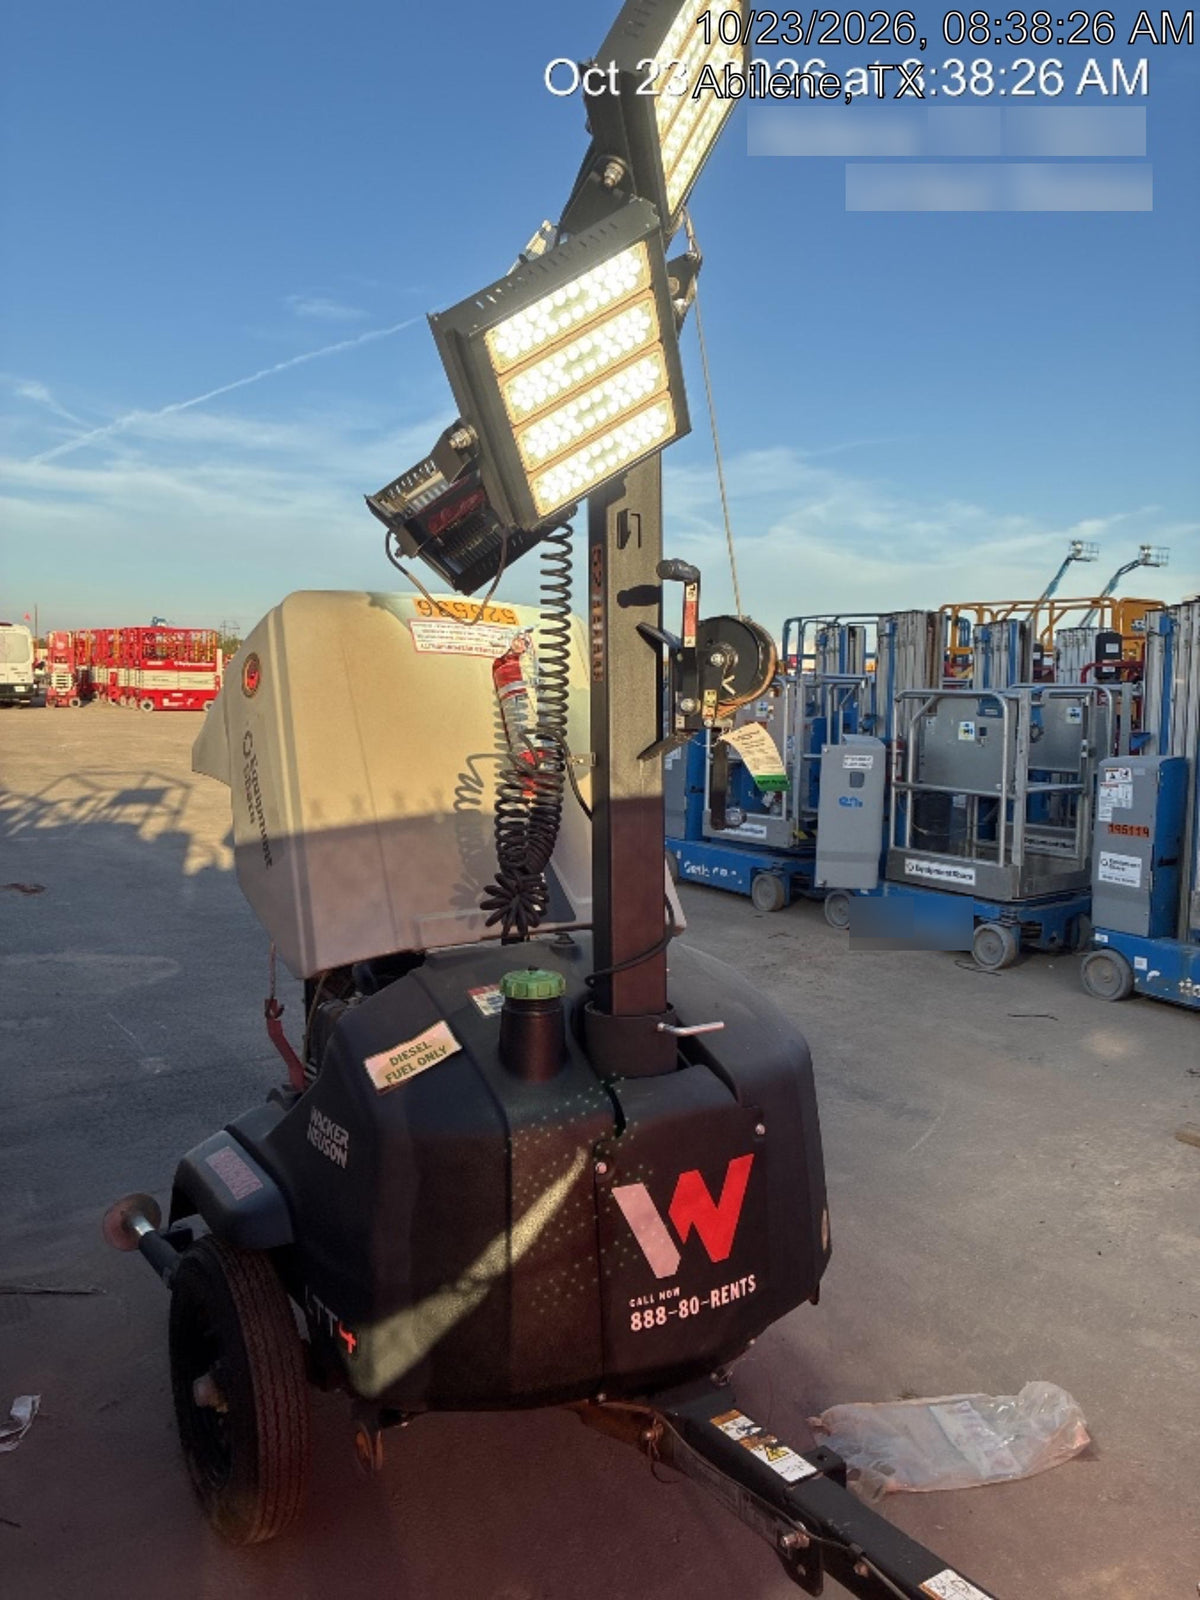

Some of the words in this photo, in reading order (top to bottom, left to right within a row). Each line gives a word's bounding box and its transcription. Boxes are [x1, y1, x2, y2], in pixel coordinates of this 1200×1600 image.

[384, 1064, 416, 1084] FUEL
[417, 1045, 448, 1066] ONLY
[389, 1040, 432, 1066] DIESEL
[307, 1123, 348, 1169] NEUSON
[311, 1106, 349, 1150] WACKER
[629, 1294, 655, 1308] CALL
[659, 1286, 681, 1300] NOW
[630, 1274, 757, 1331] 888-80-RENTS
